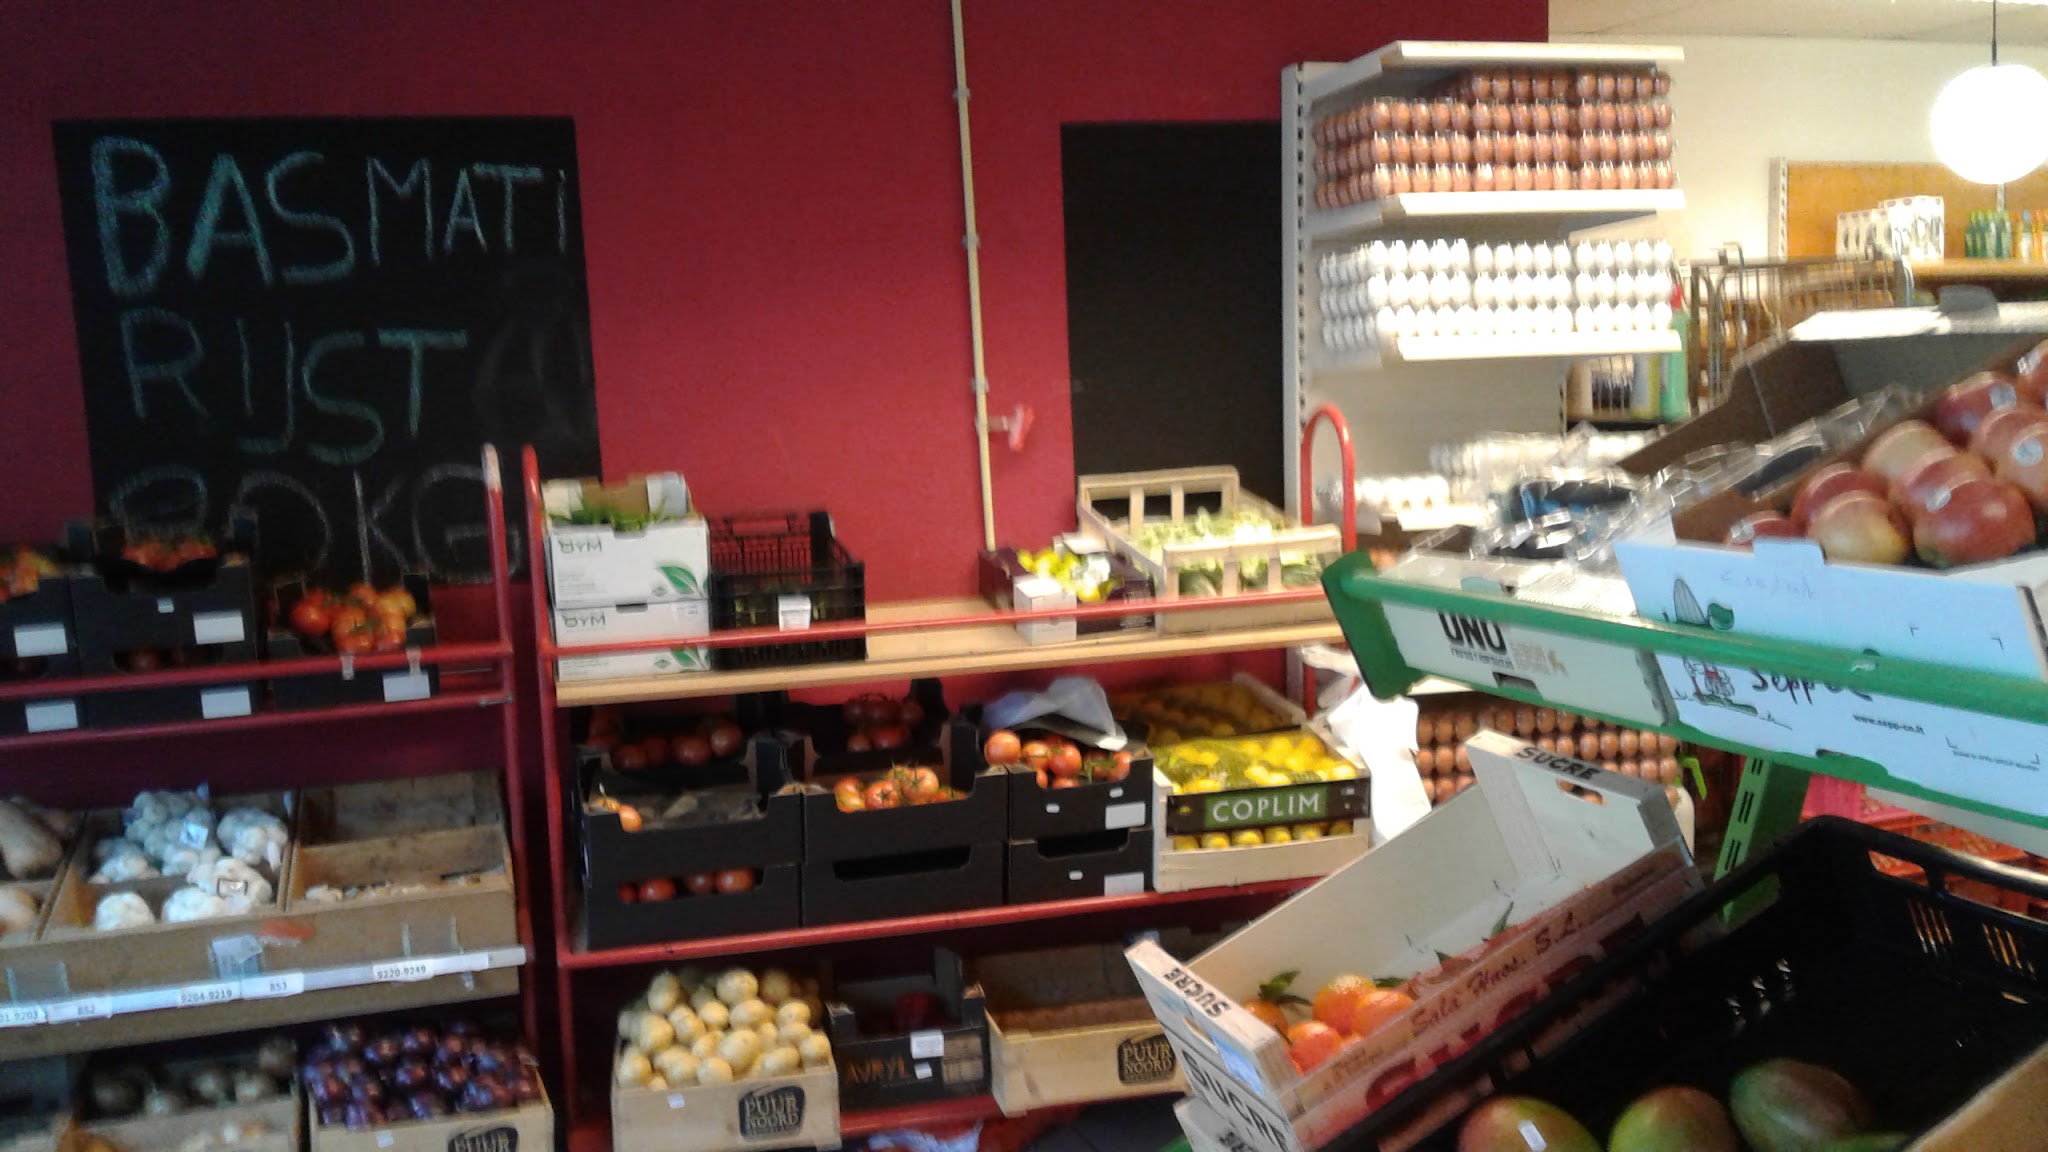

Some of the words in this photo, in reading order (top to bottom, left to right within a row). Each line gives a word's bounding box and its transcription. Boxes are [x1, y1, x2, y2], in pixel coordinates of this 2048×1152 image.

[92, 136, 567, 297] BASMATI
[120, 307, 469, 466] RIJST
[1515, 746, 1601, 780] SUCRE
[1212, 793, 1320, 822] COPLIM
[1164, 967, 1232, 1018] SUCRE
[1123, 1042, 1172, 1062] PUUR
[744, 1092, 799, 1117] PUUR
[746, 1113, 800, 1130] NOORD
